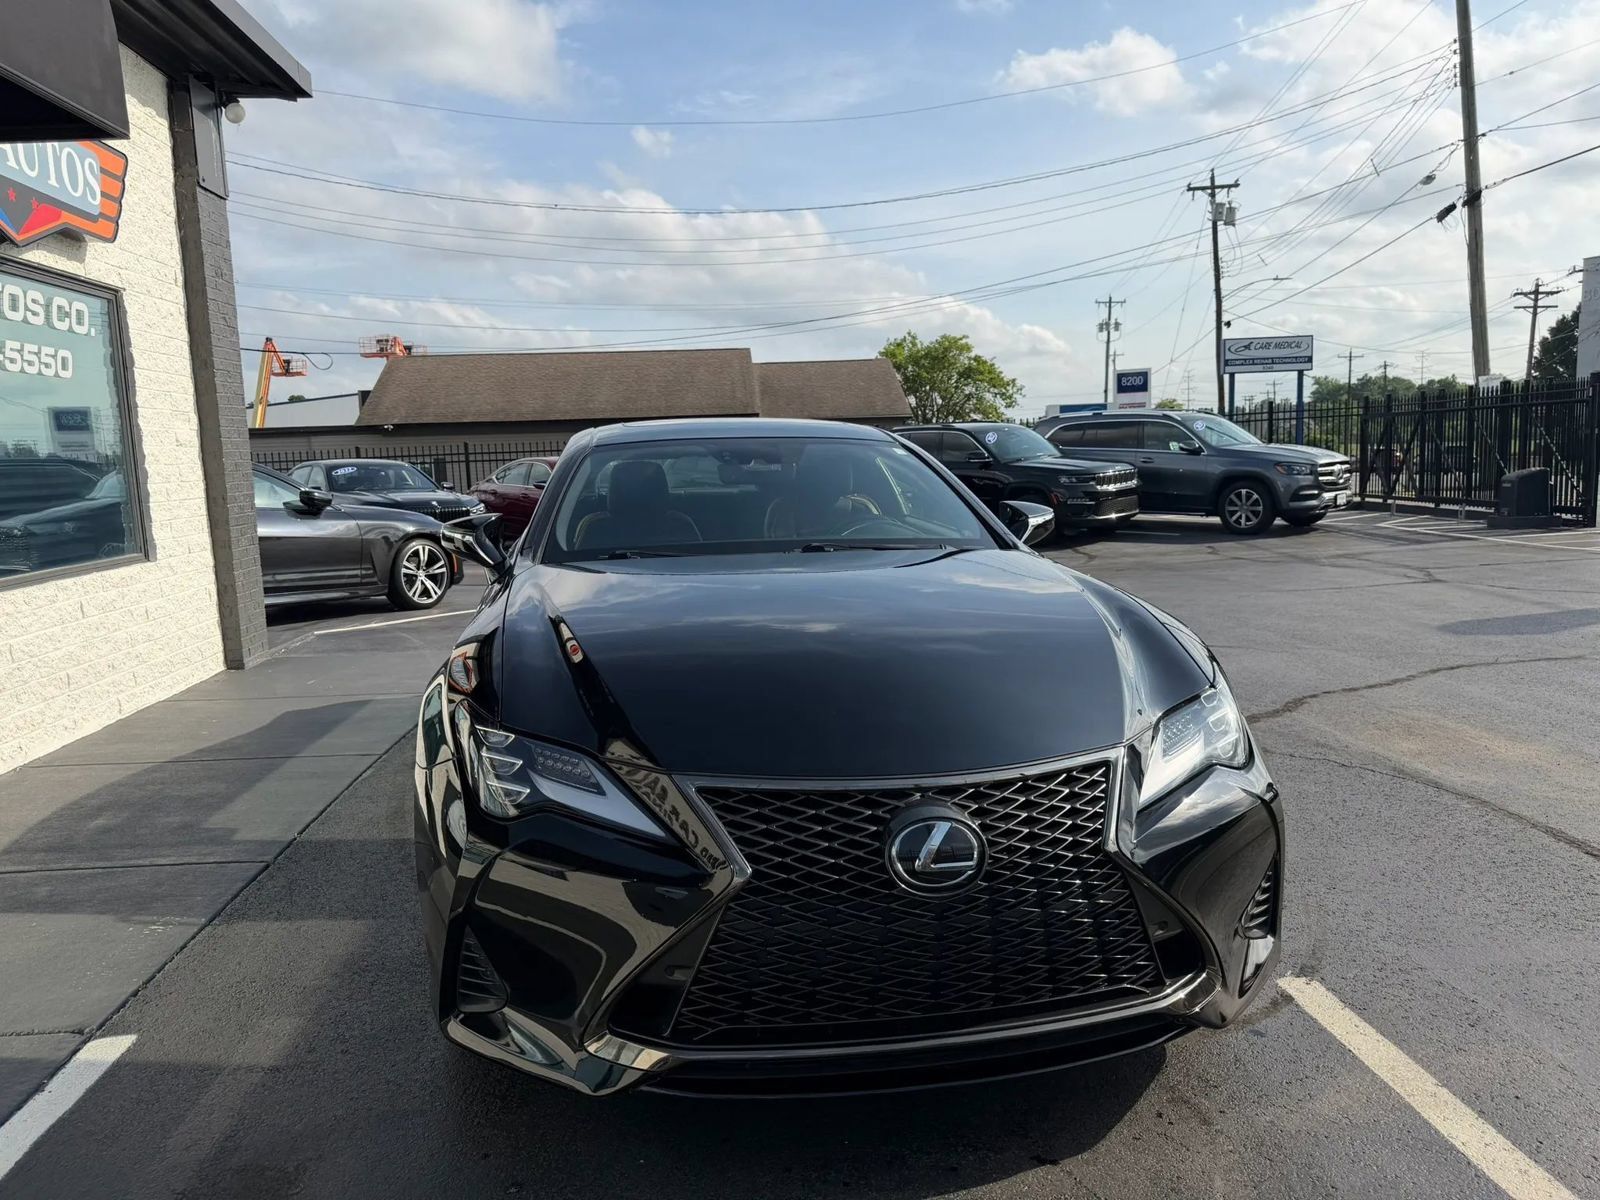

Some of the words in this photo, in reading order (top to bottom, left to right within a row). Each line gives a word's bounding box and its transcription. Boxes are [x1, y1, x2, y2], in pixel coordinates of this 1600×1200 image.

[0, 282, 45, 326] OS
[52, 296, 96, 336] CO.
[1254, 341, 1273, 351] CARE
[1272, 340, 1303, 350] MEDICAL
[1121, 375, 1144, 386] 8200
